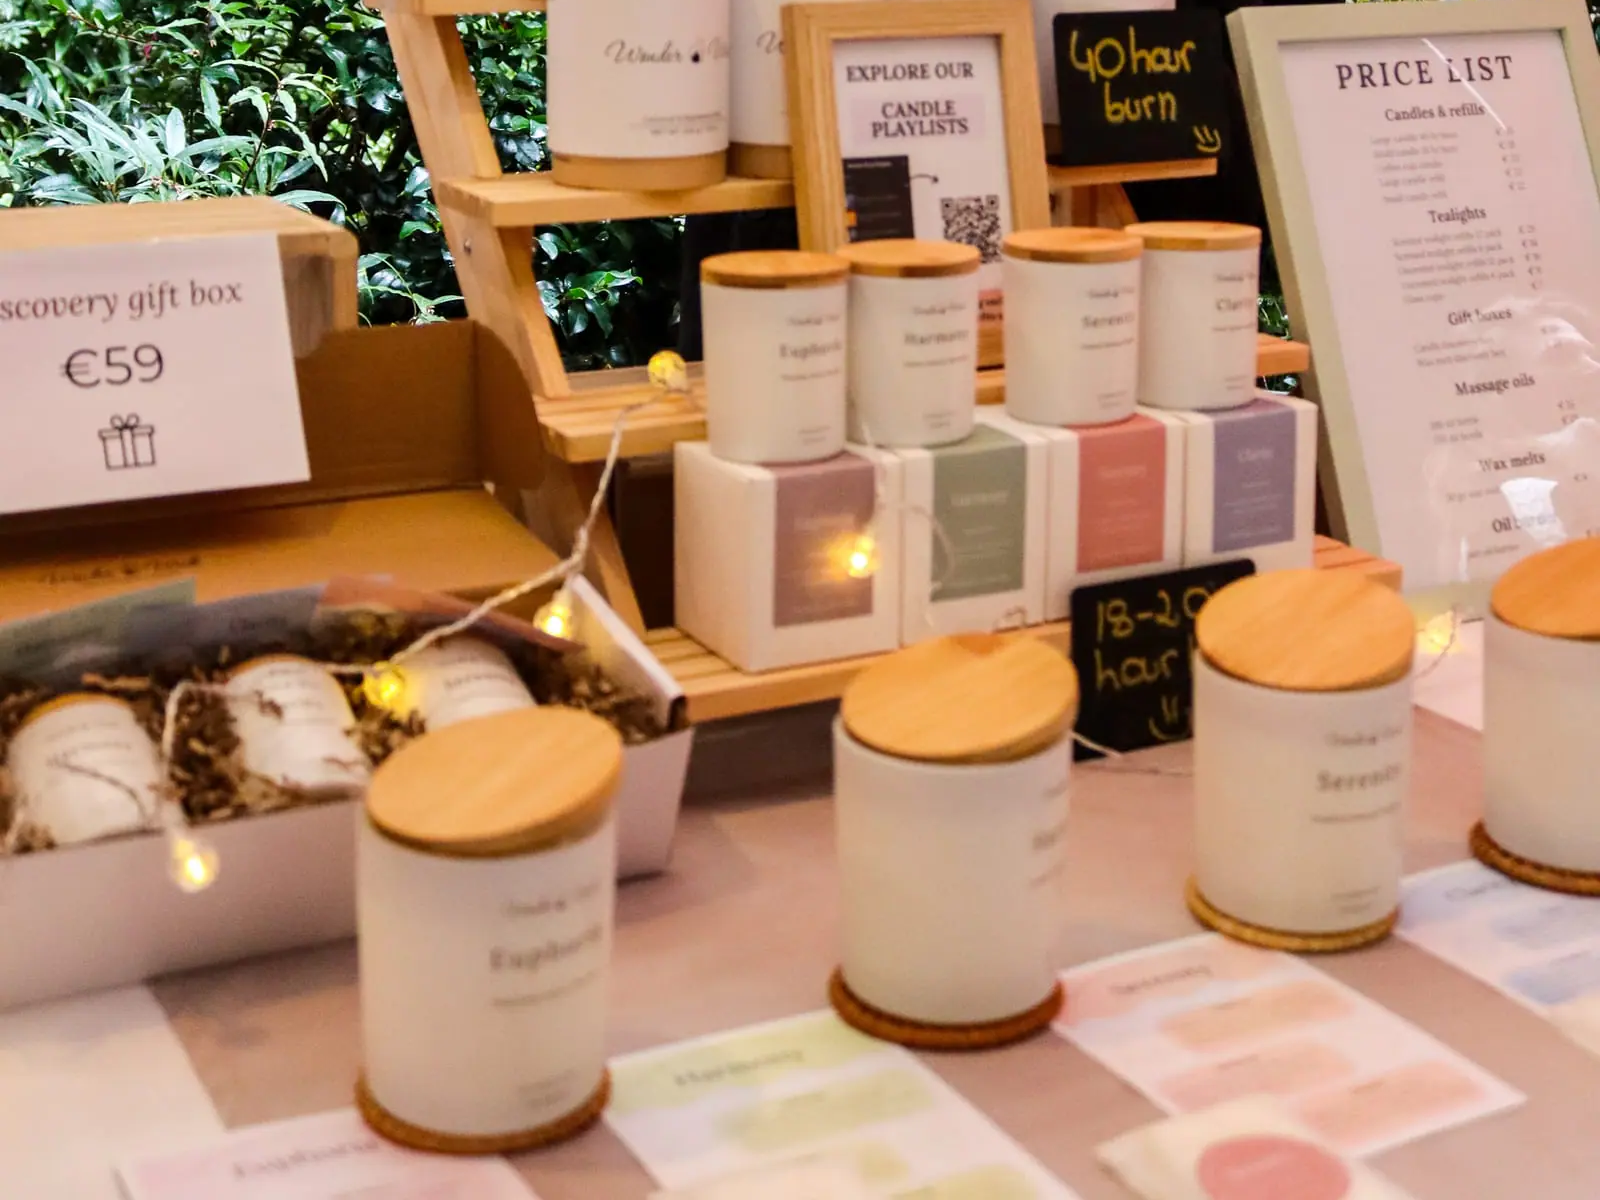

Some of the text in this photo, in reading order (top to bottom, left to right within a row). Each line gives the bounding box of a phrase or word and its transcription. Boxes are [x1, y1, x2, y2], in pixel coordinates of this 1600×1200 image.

[1070, 30, 1126, 83] 40
[846, 61, 974, 83] EXPLORE OUR
[1336, 55, 1513, 89] PRICE LIST
[881, 99, 956, 119] CANDLE
[1104, 81, 1177, 123] burn
[1385, 102, 1485, 121] Candles & refills
[872, 117, 969, 138] PLAYLISTS
[1428, 206, 1487, 224] Tealights
[128, 279, 182, 321] gift
[190, 278, 243, 306] box
[1448, 310, 1473, 326] Gift
[59, 343, 164, 390] €59
[1455, 373, 1536, 395] Massage oils
[1478, 451, 1546, 473] Wax melts
[1491, 516, 1511, 533] Oil
